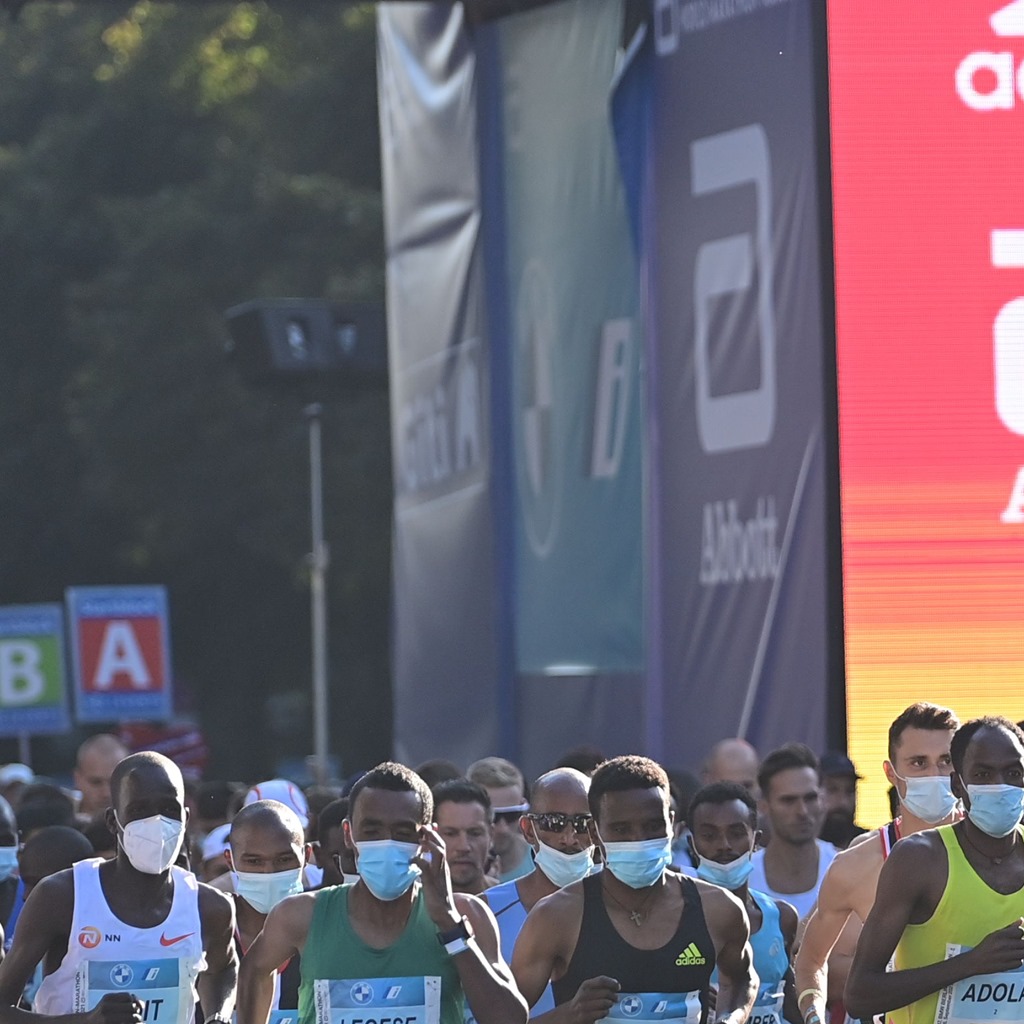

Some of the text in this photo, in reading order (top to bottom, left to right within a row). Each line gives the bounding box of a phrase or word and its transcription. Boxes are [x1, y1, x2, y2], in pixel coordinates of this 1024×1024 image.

[0, 639, 44, 704] B
[93, 618, 150, 691] A
[104, 934, 121, 942] NN
[675, 957, 706, 966] adidas
